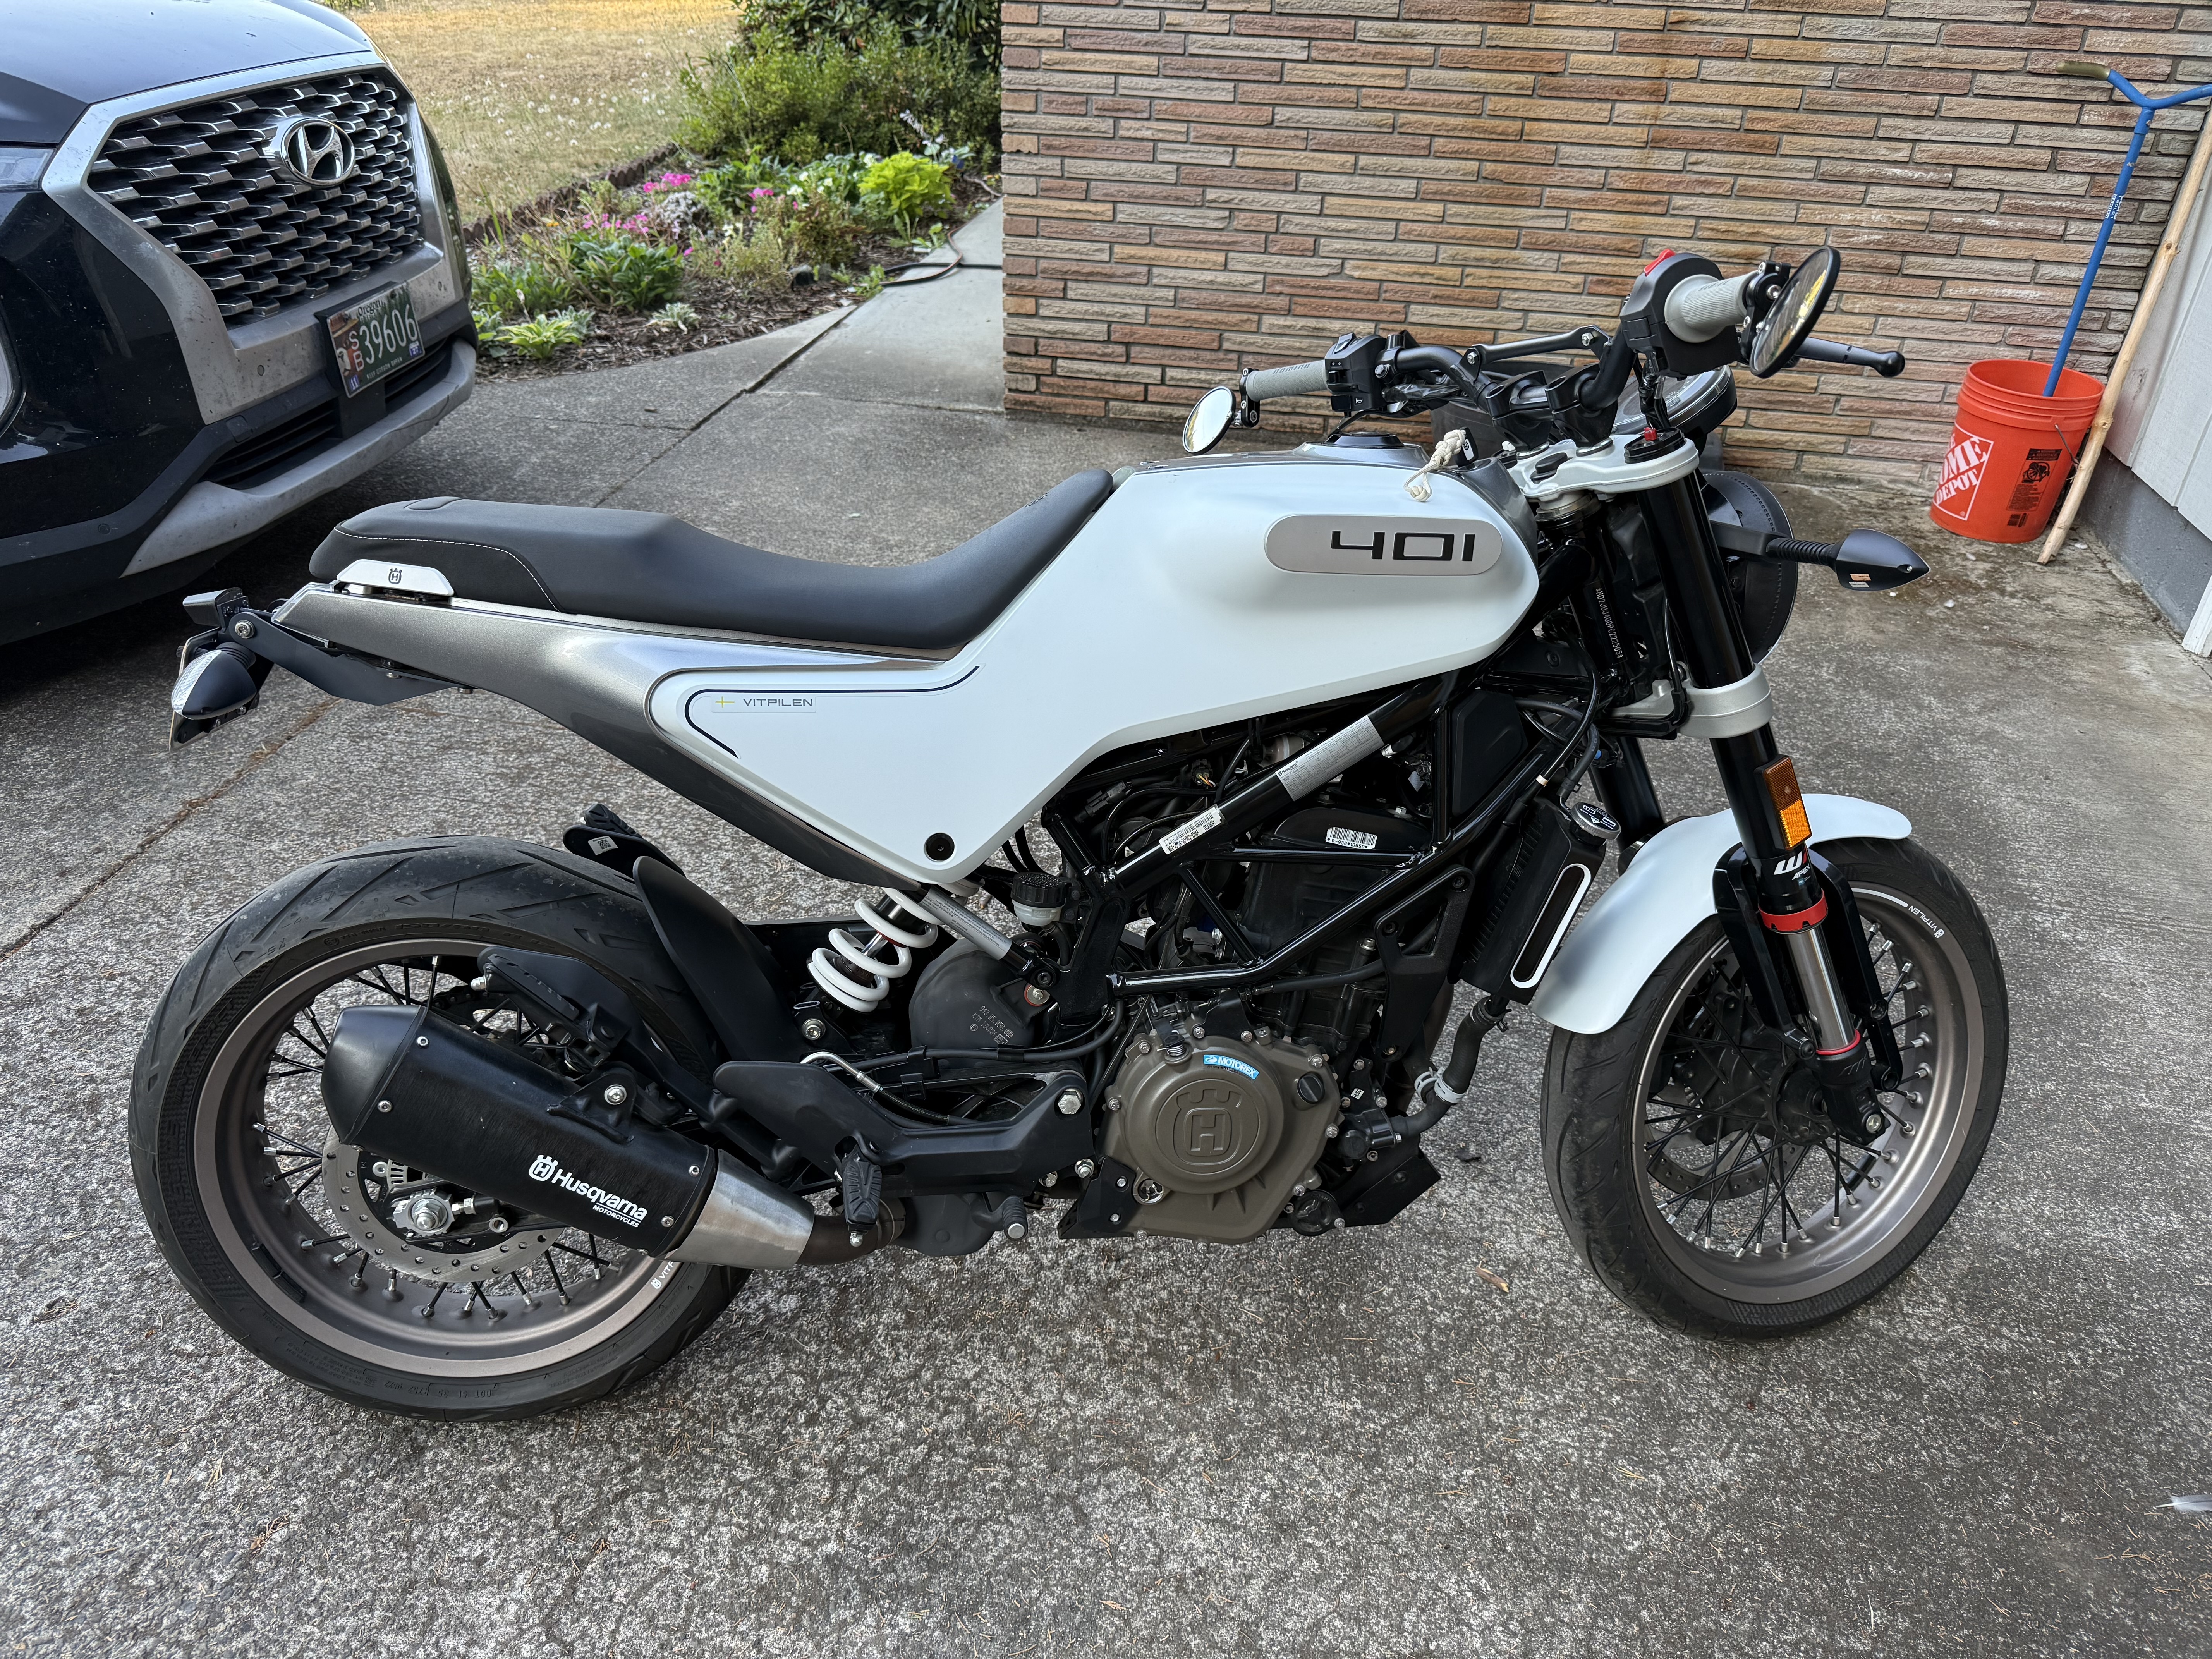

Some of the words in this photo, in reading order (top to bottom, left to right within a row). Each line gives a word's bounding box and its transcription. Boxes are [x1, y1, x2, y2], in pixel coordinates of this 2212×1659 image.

[358, 300, 382, 316] Oregon
[360, 304, 418, 364] 39606
[1939, 437, 1987, 485] OME
[1936, 469, 1978, 505] DEPOT
[1331, 531, 1475, 561] 401
[743, 698, 813, 707] VITPILEN
[1792, 863, 1811, 880] APEX
[1908, 905, 1937, 931] VITPILEN
[968, 1012, 982, 1022] KTM
[1218, 1056, 1256, 1078] MOTOREX
[551, 1168, 648, 1221] Husqvarna
[593, 1204, 640, 1228] MOTORCYCLES
[659, 1261, 674, 1279] VITP
